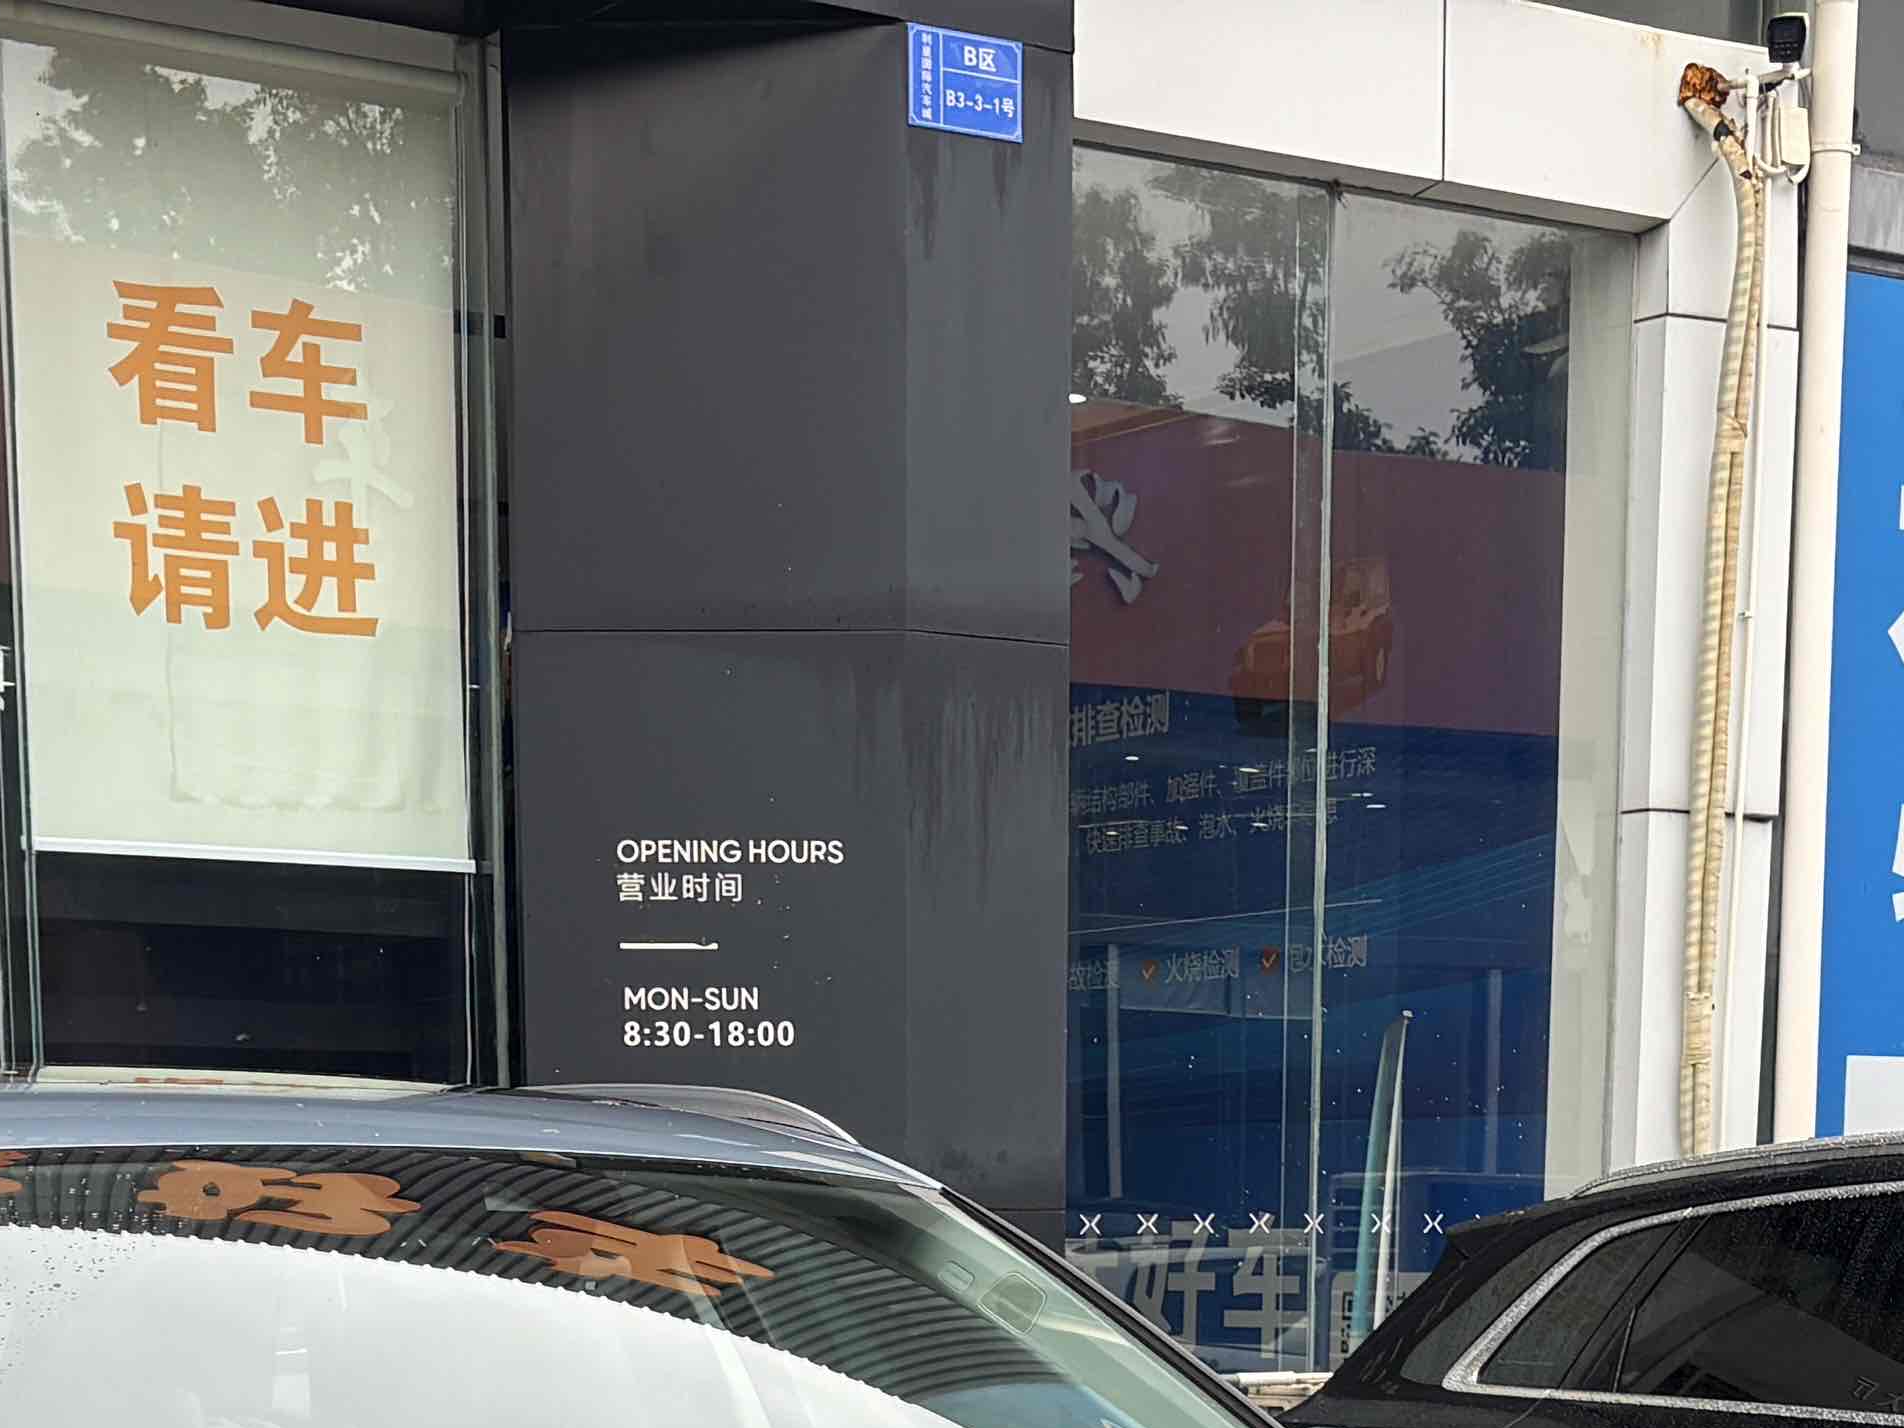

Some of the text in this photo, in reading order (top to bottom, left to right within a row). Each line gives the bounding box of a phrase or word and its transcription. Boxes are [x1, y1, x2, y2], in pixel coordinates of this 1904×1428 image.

[963, 45, 997, 72] B区
[945, 89, 1016, 118] B3-3-1号
[106, 280, 368, 446] 看车
[112, 482, 379, 638] 请进
[616, 839, 844, 864] OPENING HOURS
[616, 872, 743, 902] 营业时间
[623, 987, 759, 1011] MON-SUN
[623, 1021, 795, 1047] 8:30-18:00
